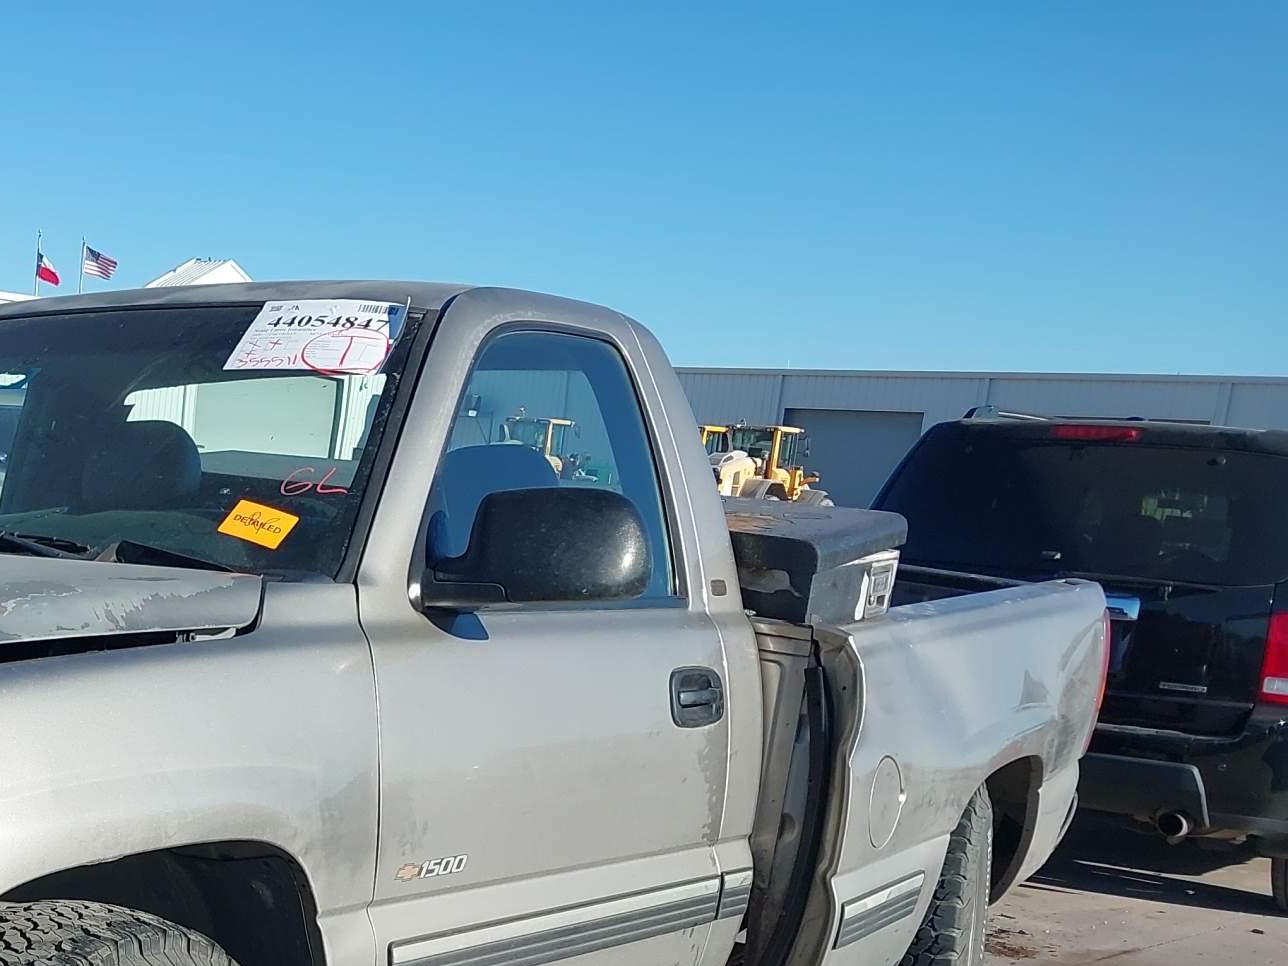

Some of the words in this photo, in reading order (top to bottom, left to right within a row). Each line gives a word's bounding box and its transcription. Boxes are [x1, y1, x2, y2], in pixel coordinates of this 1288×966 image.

[267, 314, 390, 332] 44054847
[233, 513, 282, 534] DETAILED
[418, 853, 468, 880] 1500
